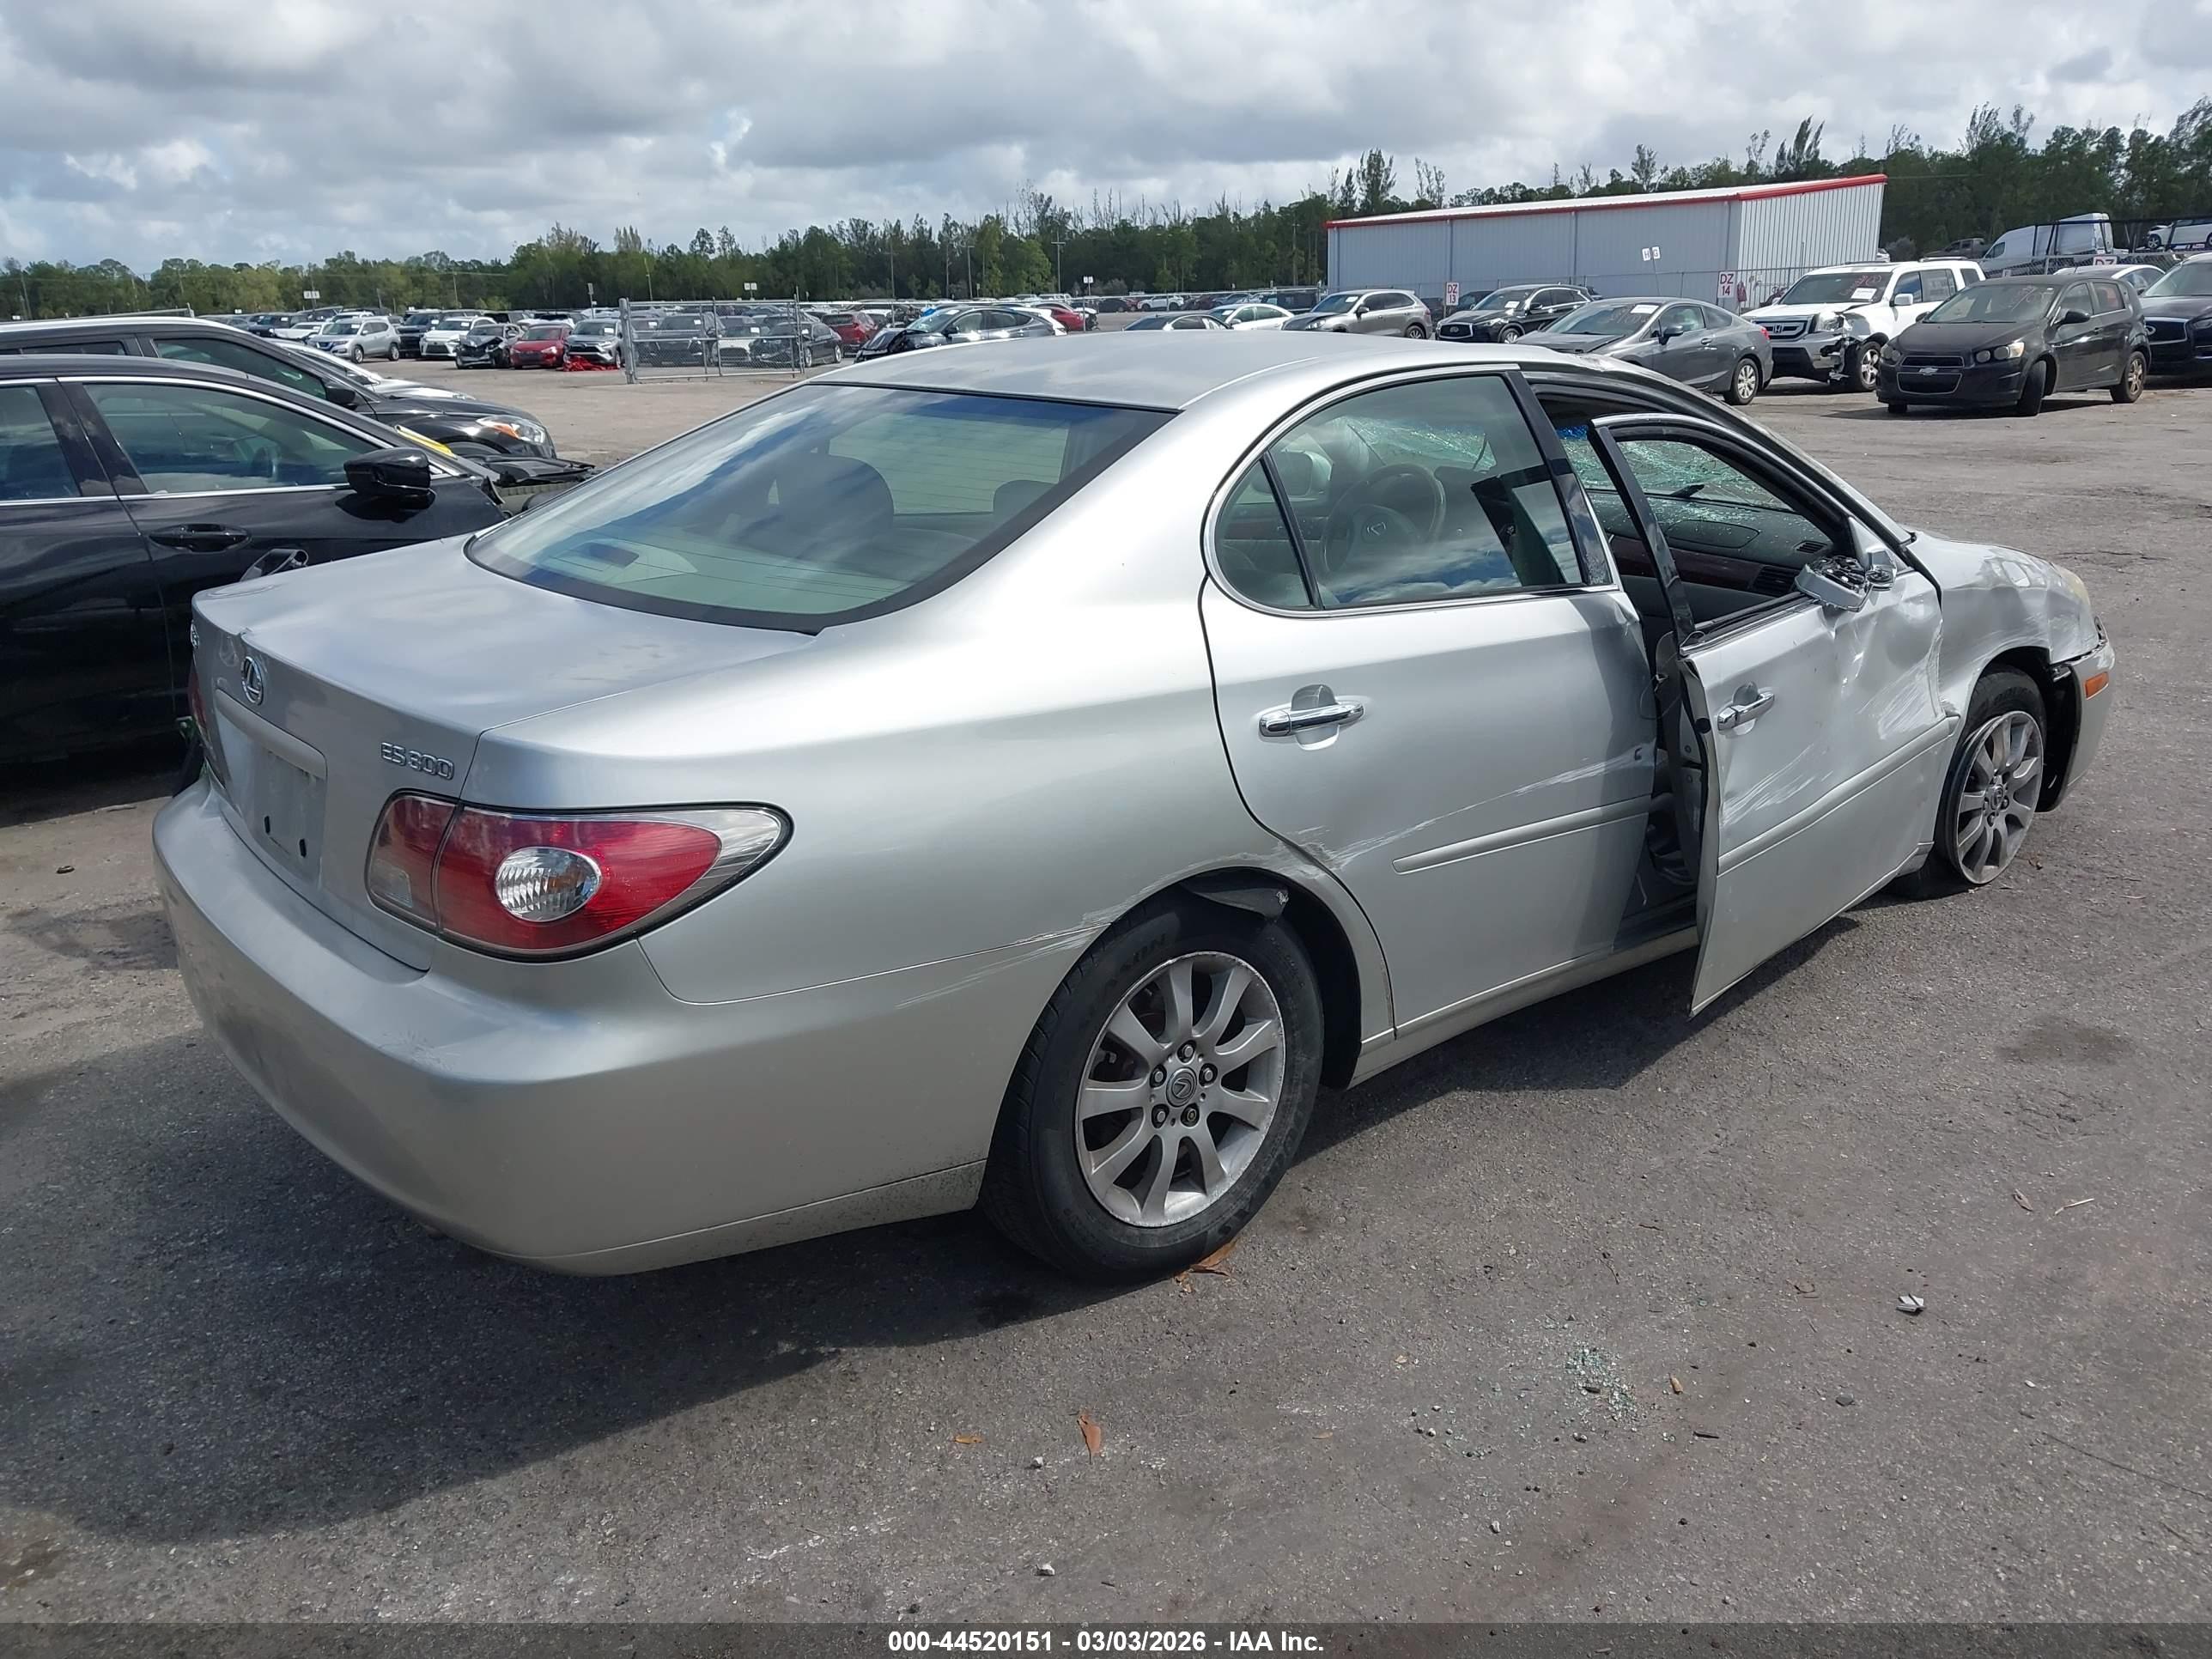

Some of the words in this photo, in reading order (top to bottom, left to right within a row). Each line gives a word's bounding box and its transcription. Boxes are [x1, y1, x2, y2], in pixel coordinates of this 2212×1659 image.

[1720, 273, 1734, 284] DZ
[1448, 284, 1457, 294] DZ
[1723, 285, 1730, 296] 14
[1449, 295, 1456, 304] 13
[380, 741, 407, 767] ES
